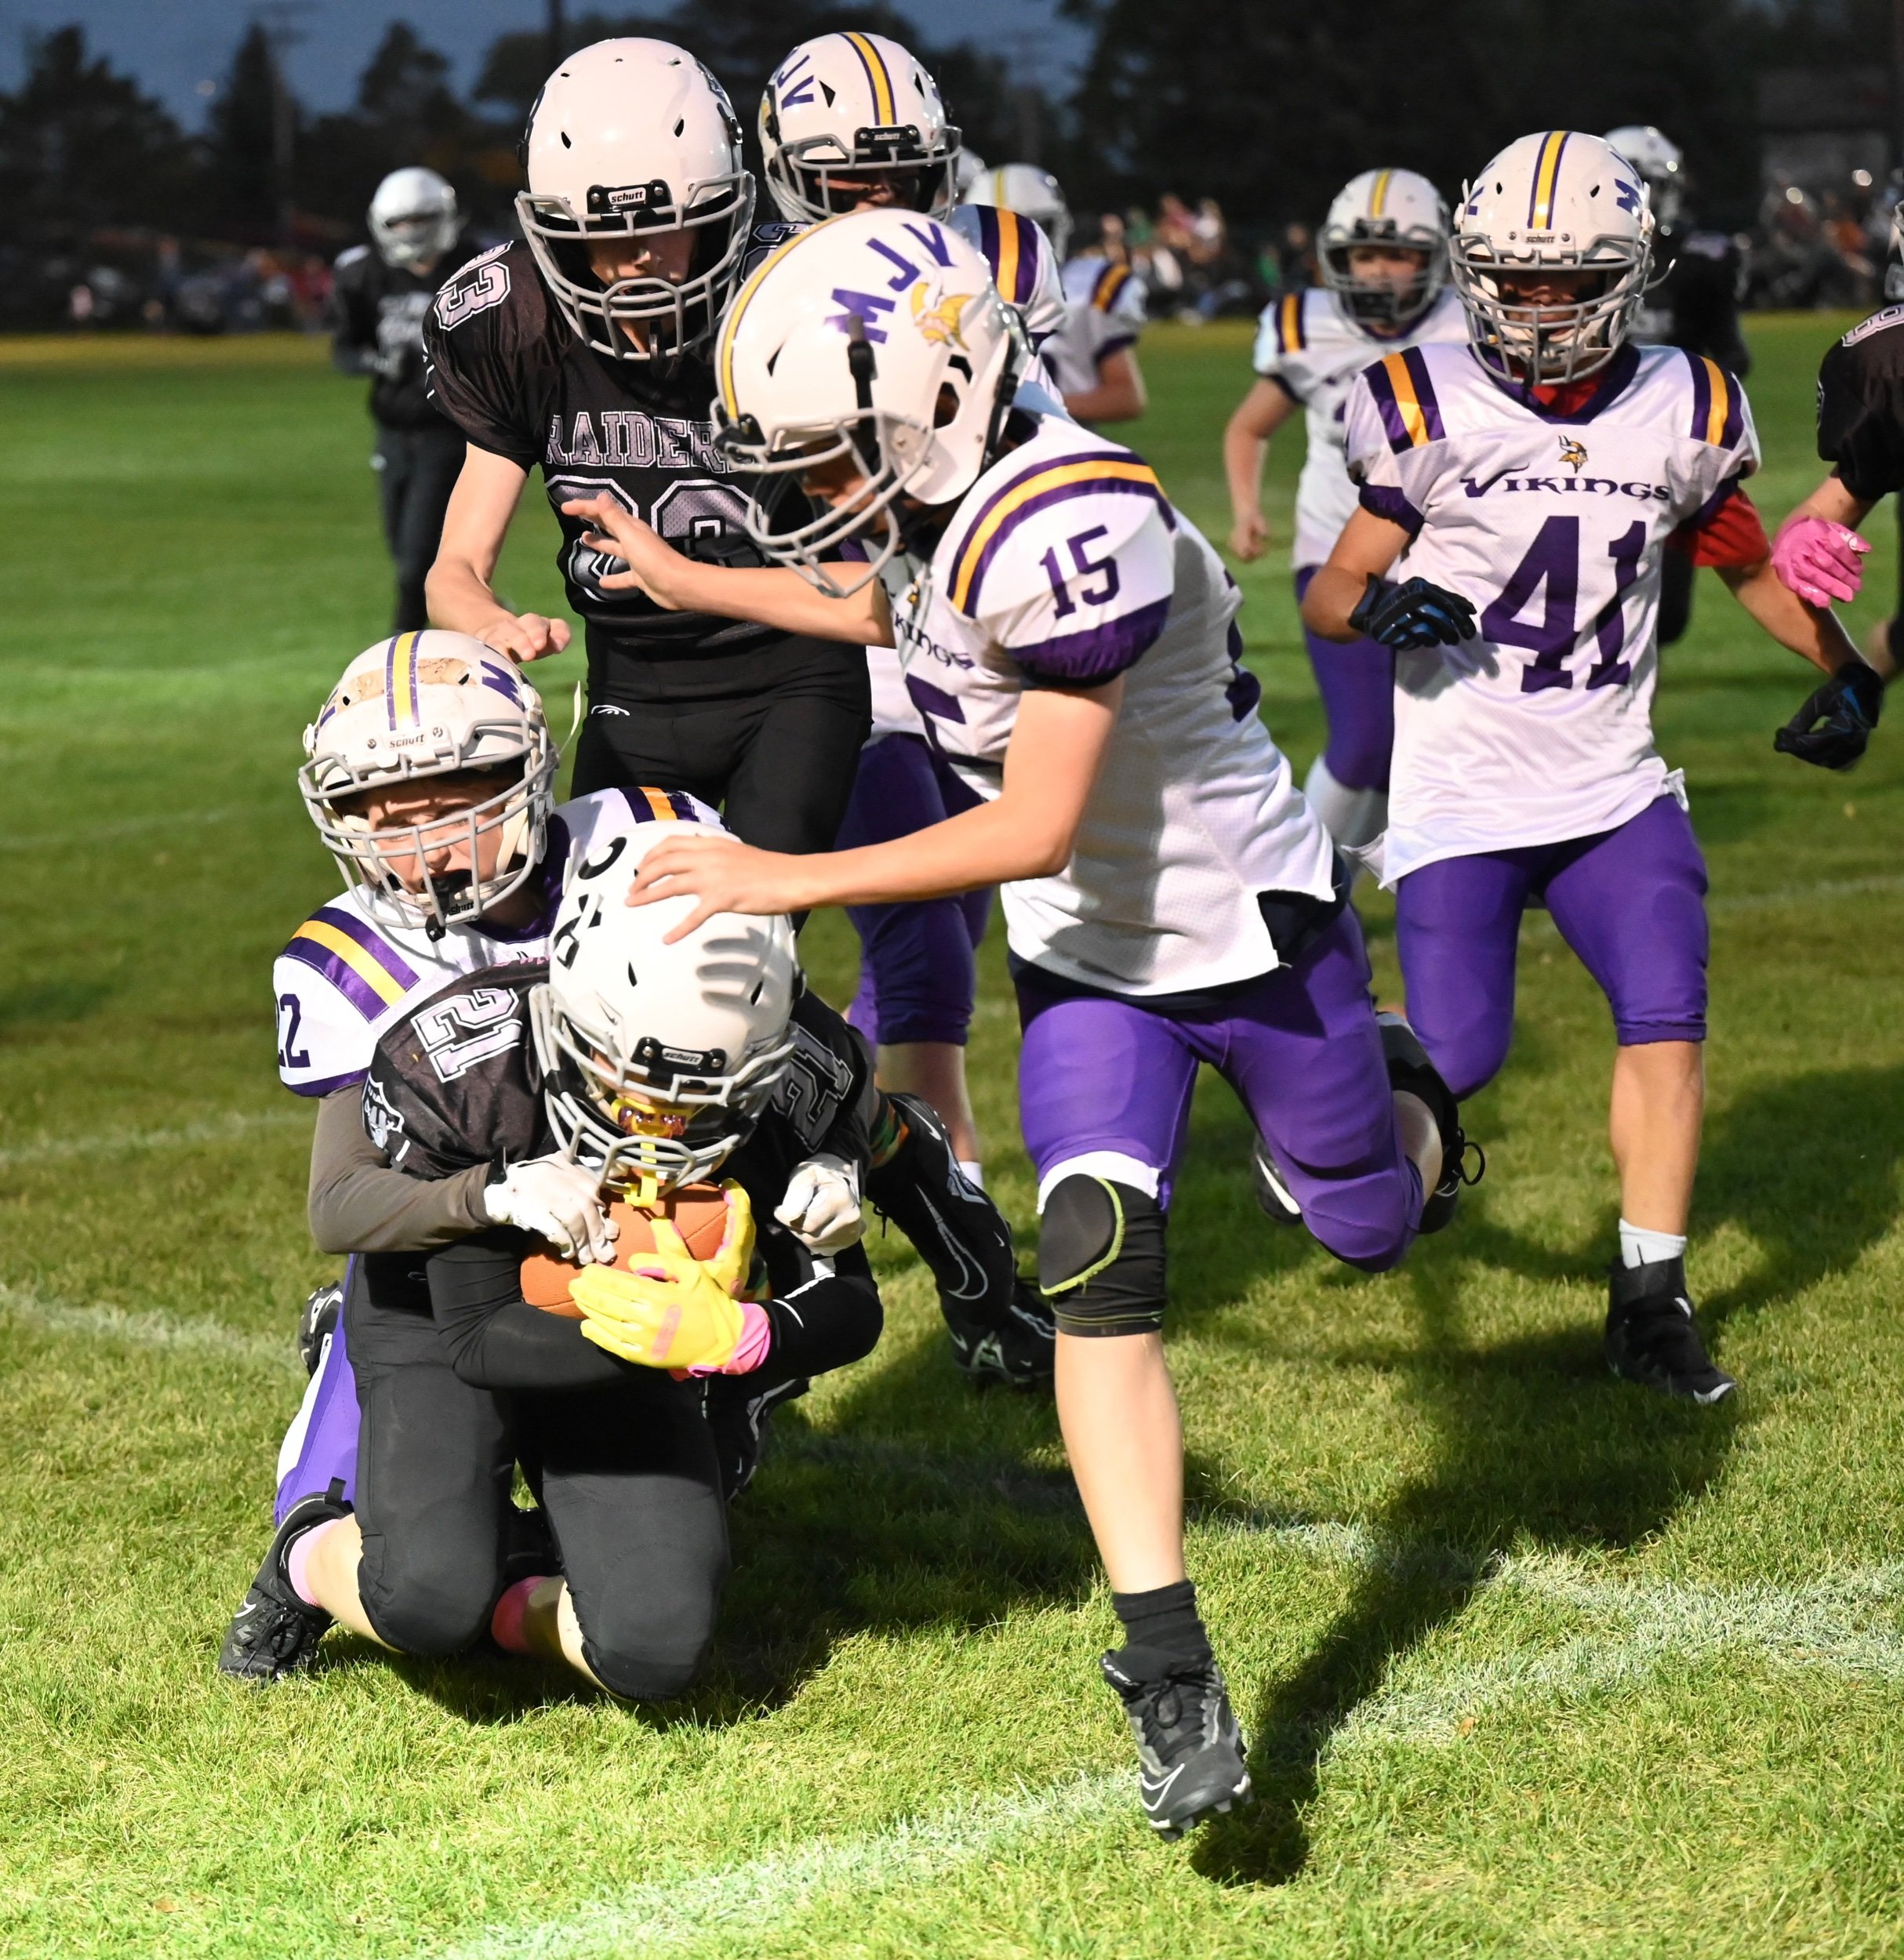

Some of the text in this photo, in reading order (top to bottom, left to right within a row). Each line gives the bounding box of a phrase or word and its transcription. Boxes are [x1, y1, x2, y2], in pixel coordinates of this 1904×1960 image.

[769, 46, 815, 111] JV
[612, 191, 643, 203] schutt
[433, 240, 514, 332] 3
[823, 221, 958, 345] MJV
[546, 411, 754, 474] RAIDER
[1039, 524, 1120, 620] 15
[1480, 514, 1647, 693] 41
[277, 993, 311, 1069] 2
[409, 986, 523, 1083] 21
[663, 1052, 699, 1063] schutt
[769, 1020, 854, 1154] 21
